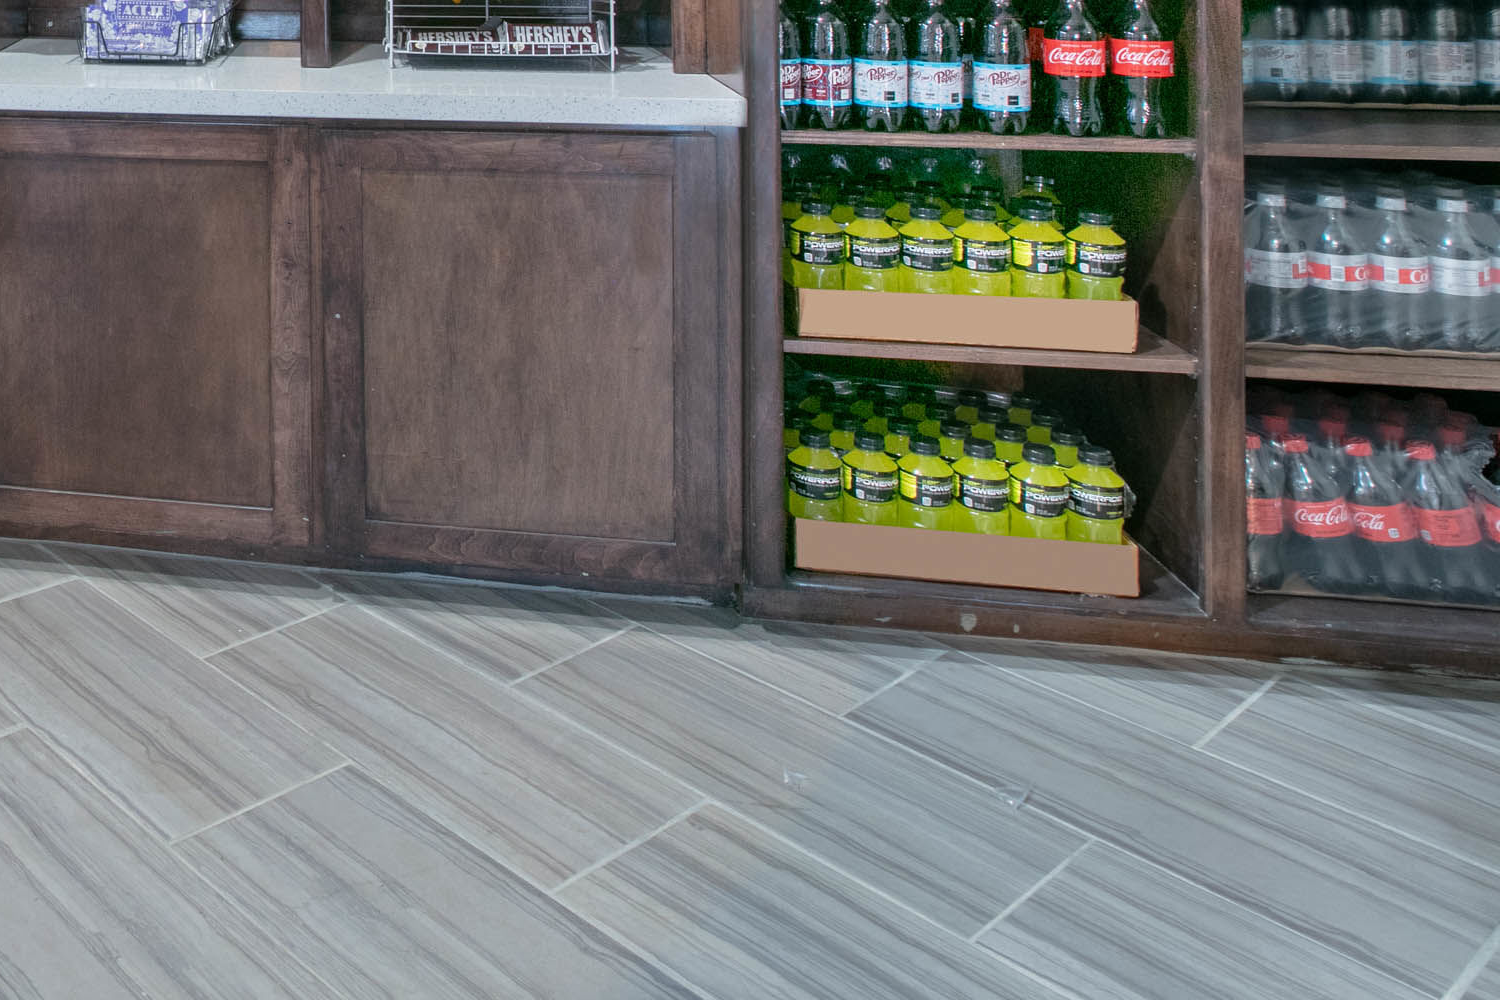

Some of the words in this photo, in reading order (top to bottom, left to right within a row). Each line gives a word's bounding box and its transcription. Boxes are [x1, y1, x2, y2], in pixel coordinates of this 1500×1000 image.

[123, 5, 145, 16] ACT
[419, 30, 493, 43] HERSHEY'S
[515, 24, 593, 44] HERSHEY'S
[1049, 48, 1101, 65] Coca-Cola
[1116, 48, 1170, 65] Coca-Cola
[868, 68, 895, 81] Pepper
